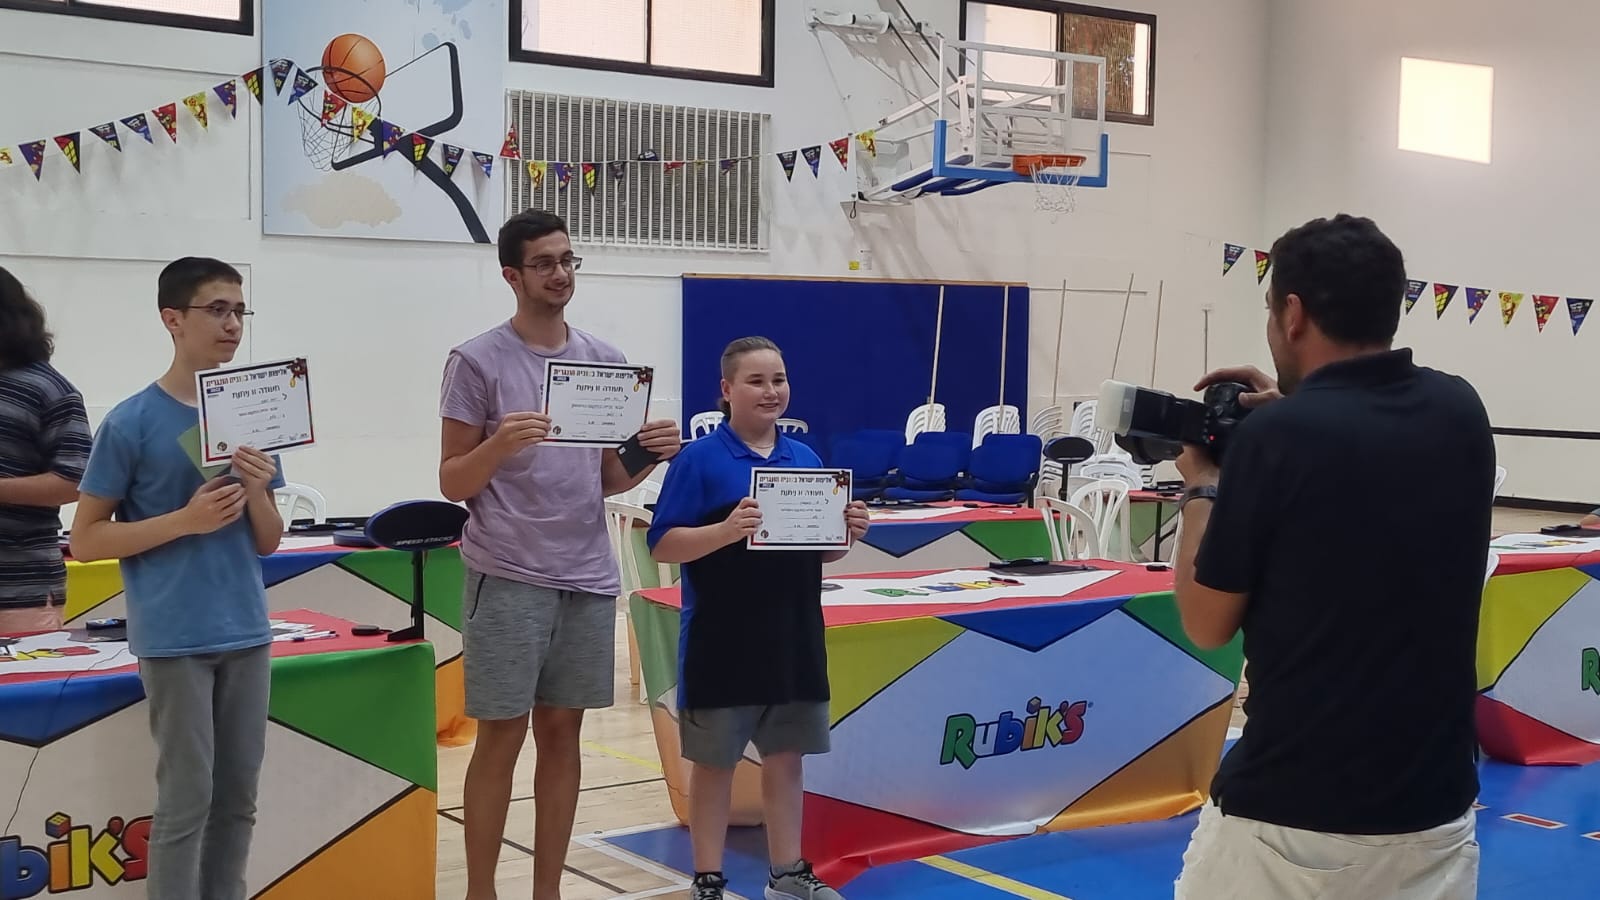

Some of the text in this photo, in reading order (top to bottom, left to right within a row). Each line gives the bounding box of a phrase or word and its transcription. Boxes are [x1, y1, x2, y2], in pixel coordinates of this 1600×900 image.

[249, 371, 267, 380] ישראל
[596, 370, 614, 379] ישראל
[259, 384, 280, 394] תעודה
[602, 385, 624, 393] תעודה
[940, 696, 1087, 770] Rubik's
